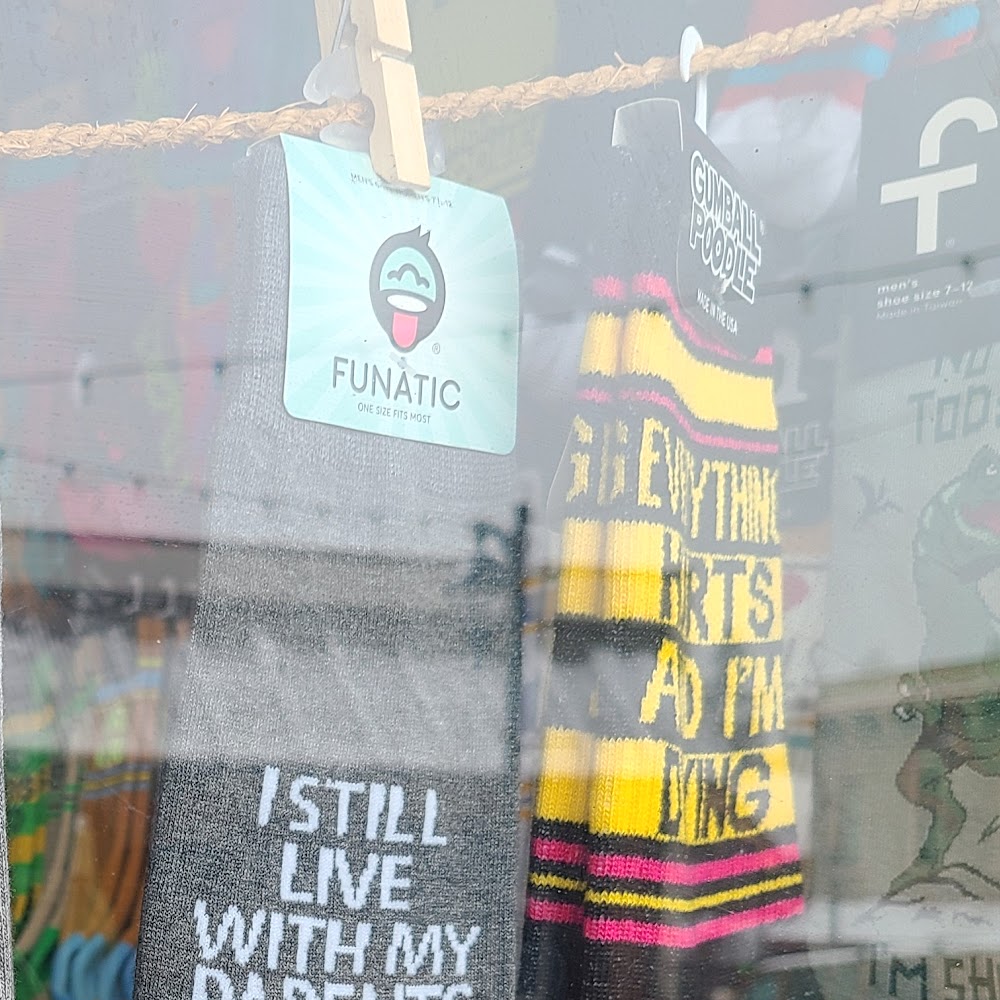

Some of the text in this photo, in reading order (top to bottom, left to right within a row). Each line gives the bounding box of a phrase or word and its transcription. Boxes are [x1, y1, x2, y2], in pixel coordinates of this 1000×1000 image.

[690, 150, 761, 267] GUMBALL
[689, 199, 757, 304] POODLE
[877, 278, 918, 295] men's
[696, 287, 709, 313] MADE
[715, 305, 726, 330] THE
[726, 312, 738, 336] USA
[877, 294, 909, 309] shoe
[913, 289, 940, 302] size
[332, 356, 461, 411] FUNATIC
[357, 402, 431, 424] ONE SIZE FITS MOST
[661, 529, 775, 641] HRTS
[640, 638, 785, 739] AD I'M
[258, 766, 447, 846] I STILL
[280, 842, 412, 911] LIVE
[194, 900, 481, 975] WITH MY
